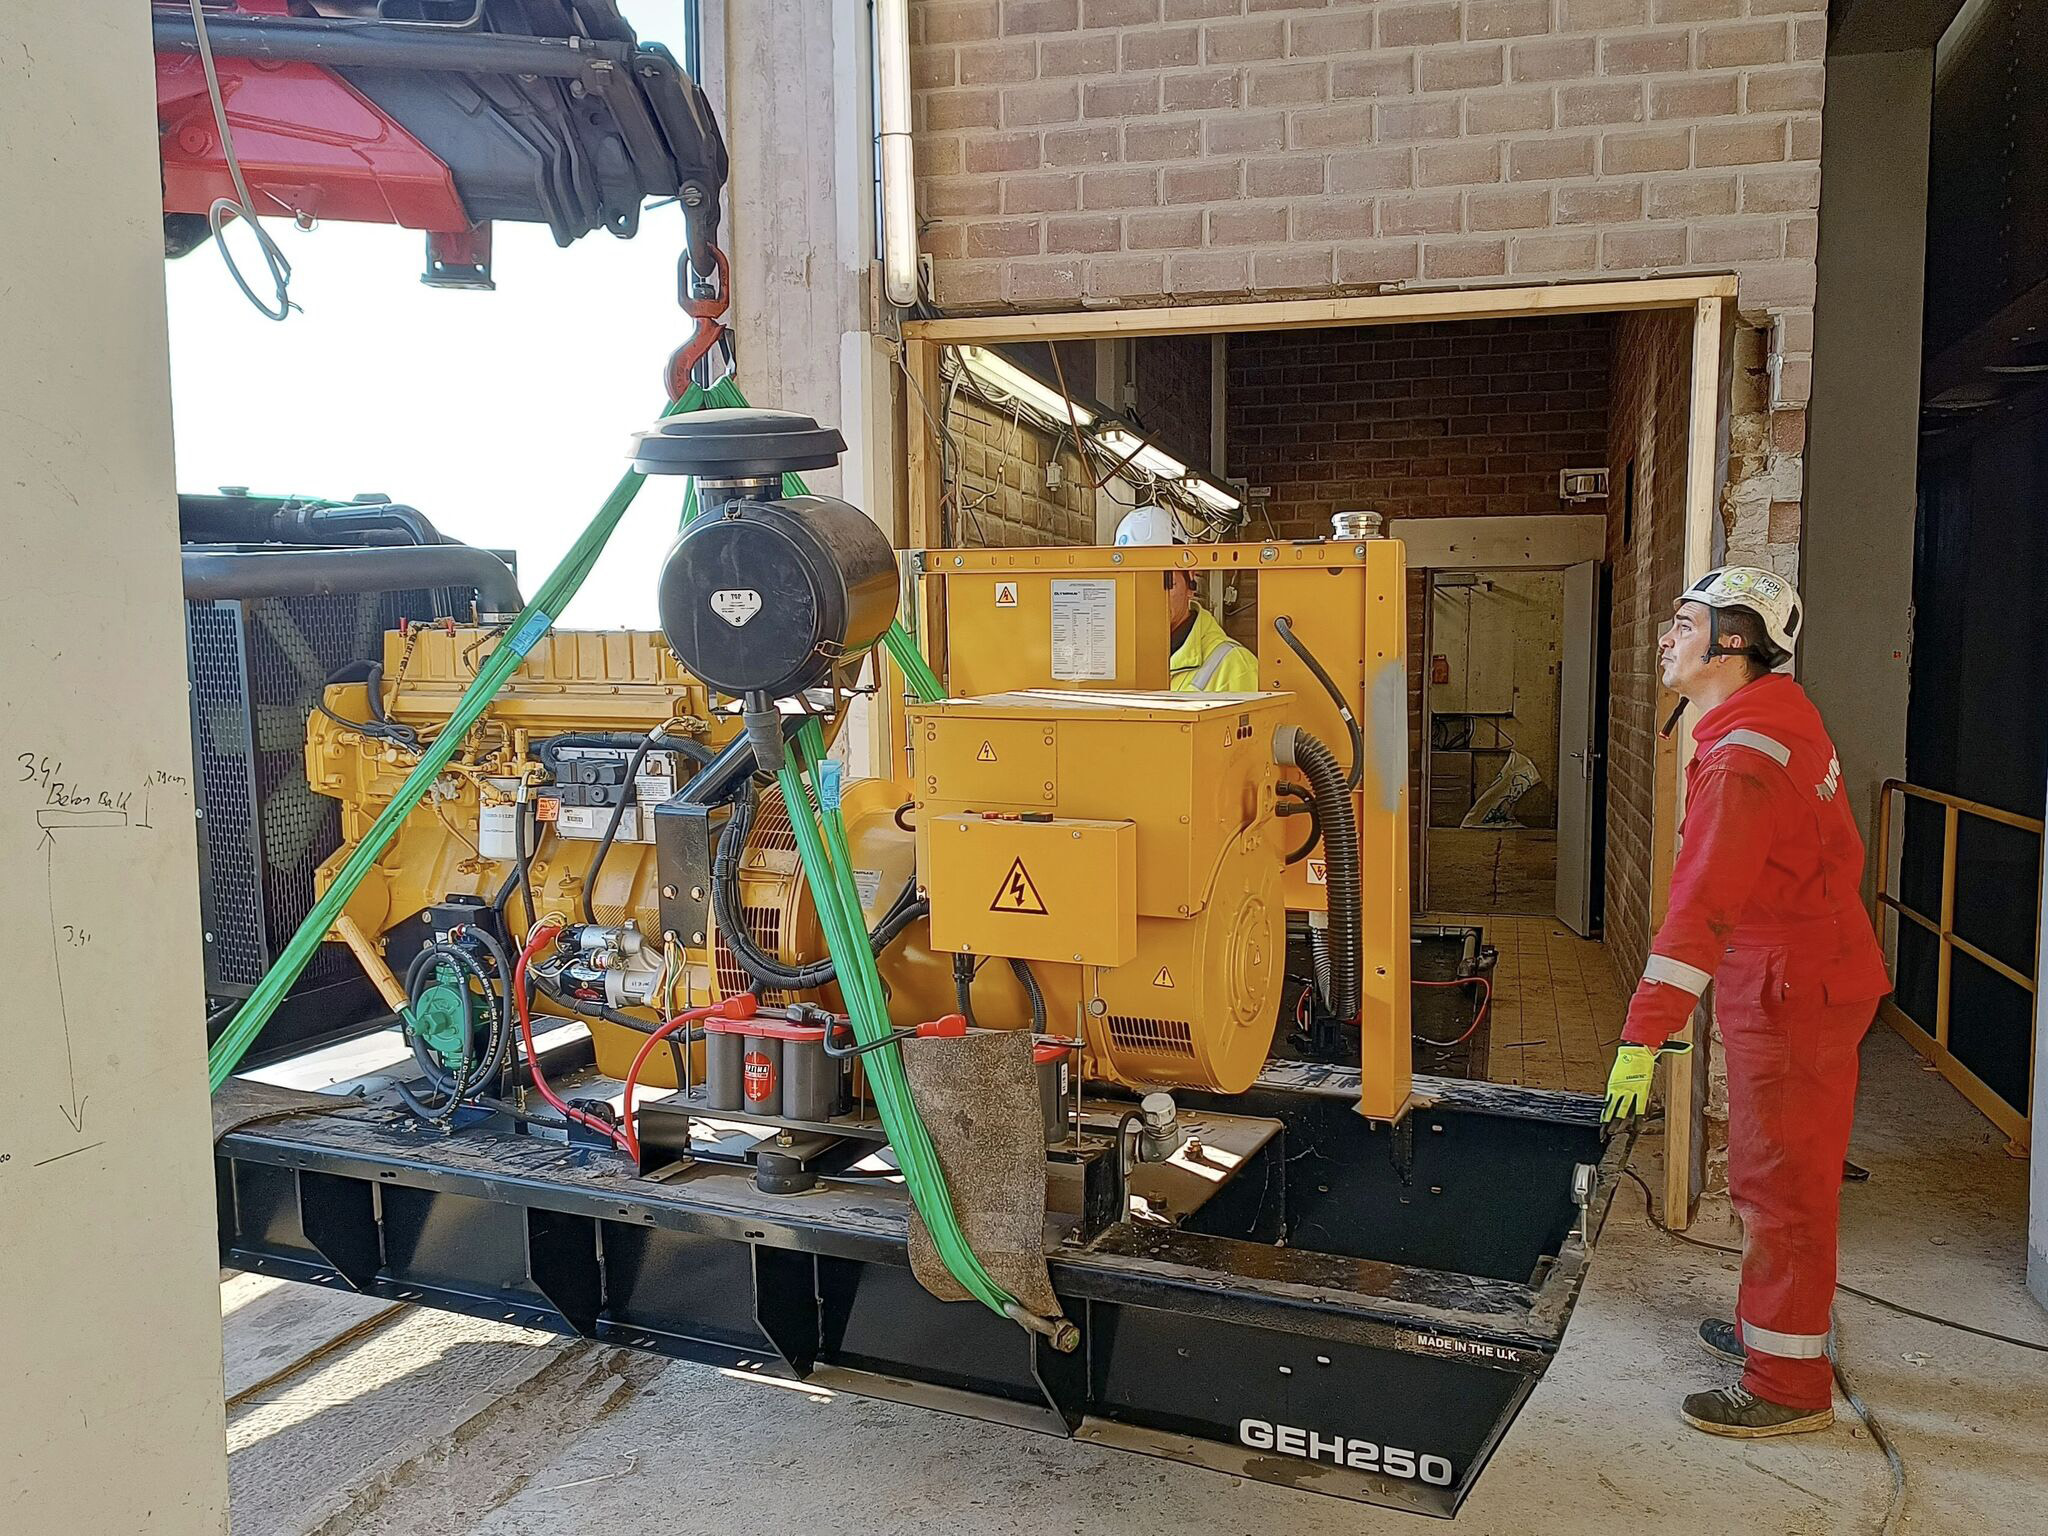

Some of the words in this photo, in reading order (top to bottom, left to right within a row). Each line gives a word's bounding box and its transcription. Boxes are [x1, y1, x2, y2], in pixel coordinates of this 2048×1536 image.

[1417, 1335, 1452, 1350] MADE
[1454, 1340, 1467, 1353] IN
[1468, 1343, 1495, 1357] THE
[1496, 1348, 1520, 1362] U.K.
[1239, 1418, 1453, 1486] GEH250
